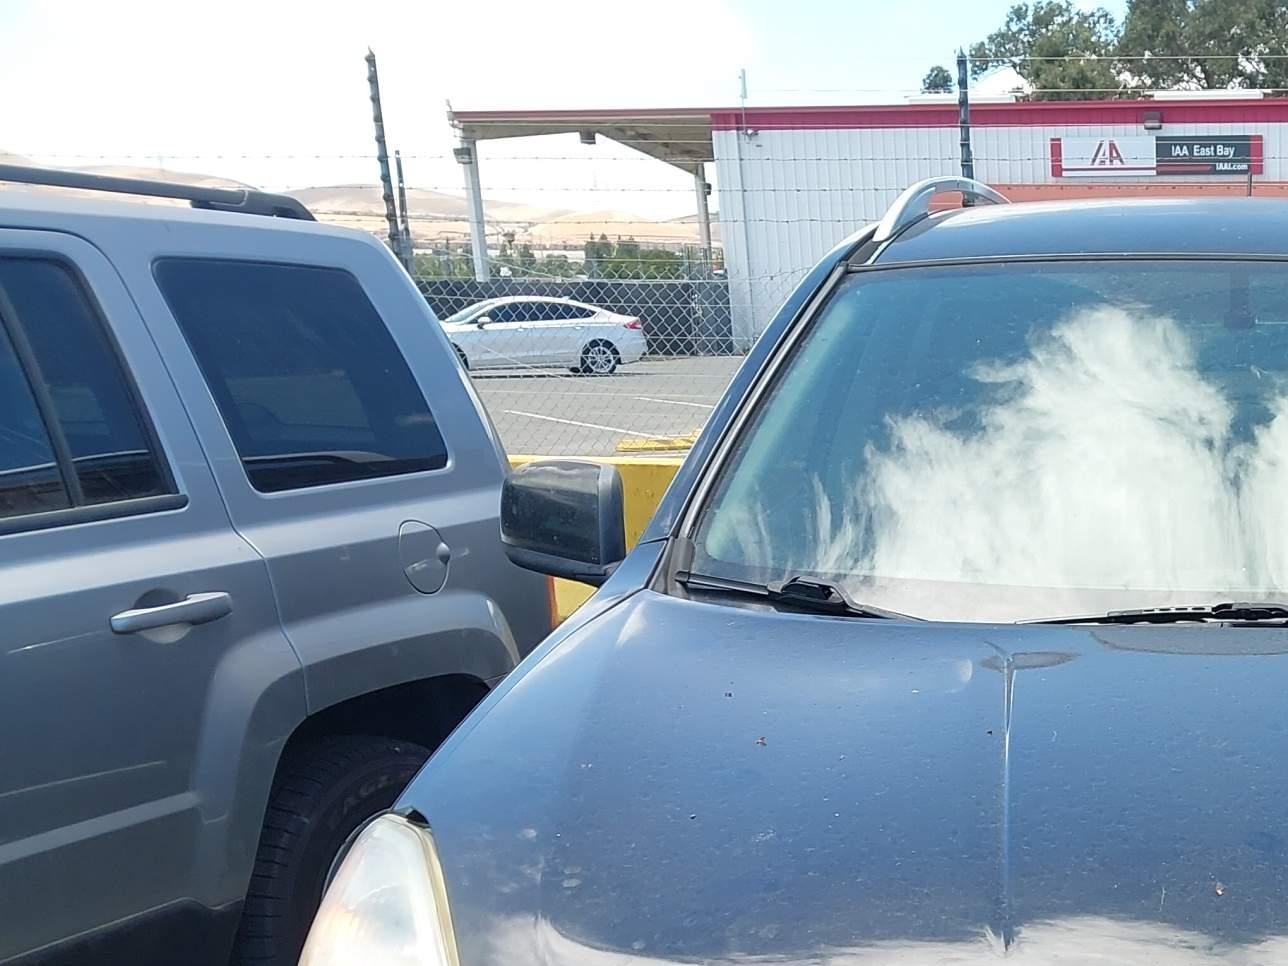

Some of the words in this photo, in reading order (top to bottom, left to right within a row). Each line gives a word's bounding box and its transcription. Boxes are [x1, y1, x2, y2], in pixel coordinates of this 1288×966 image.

[1171, 145, 1189, 157] IAA
[1193, 144, 1215, 156] East
[1216, 144, 1236, 159] Bay
[1216, 162, 1248, 171] IAAI.com
